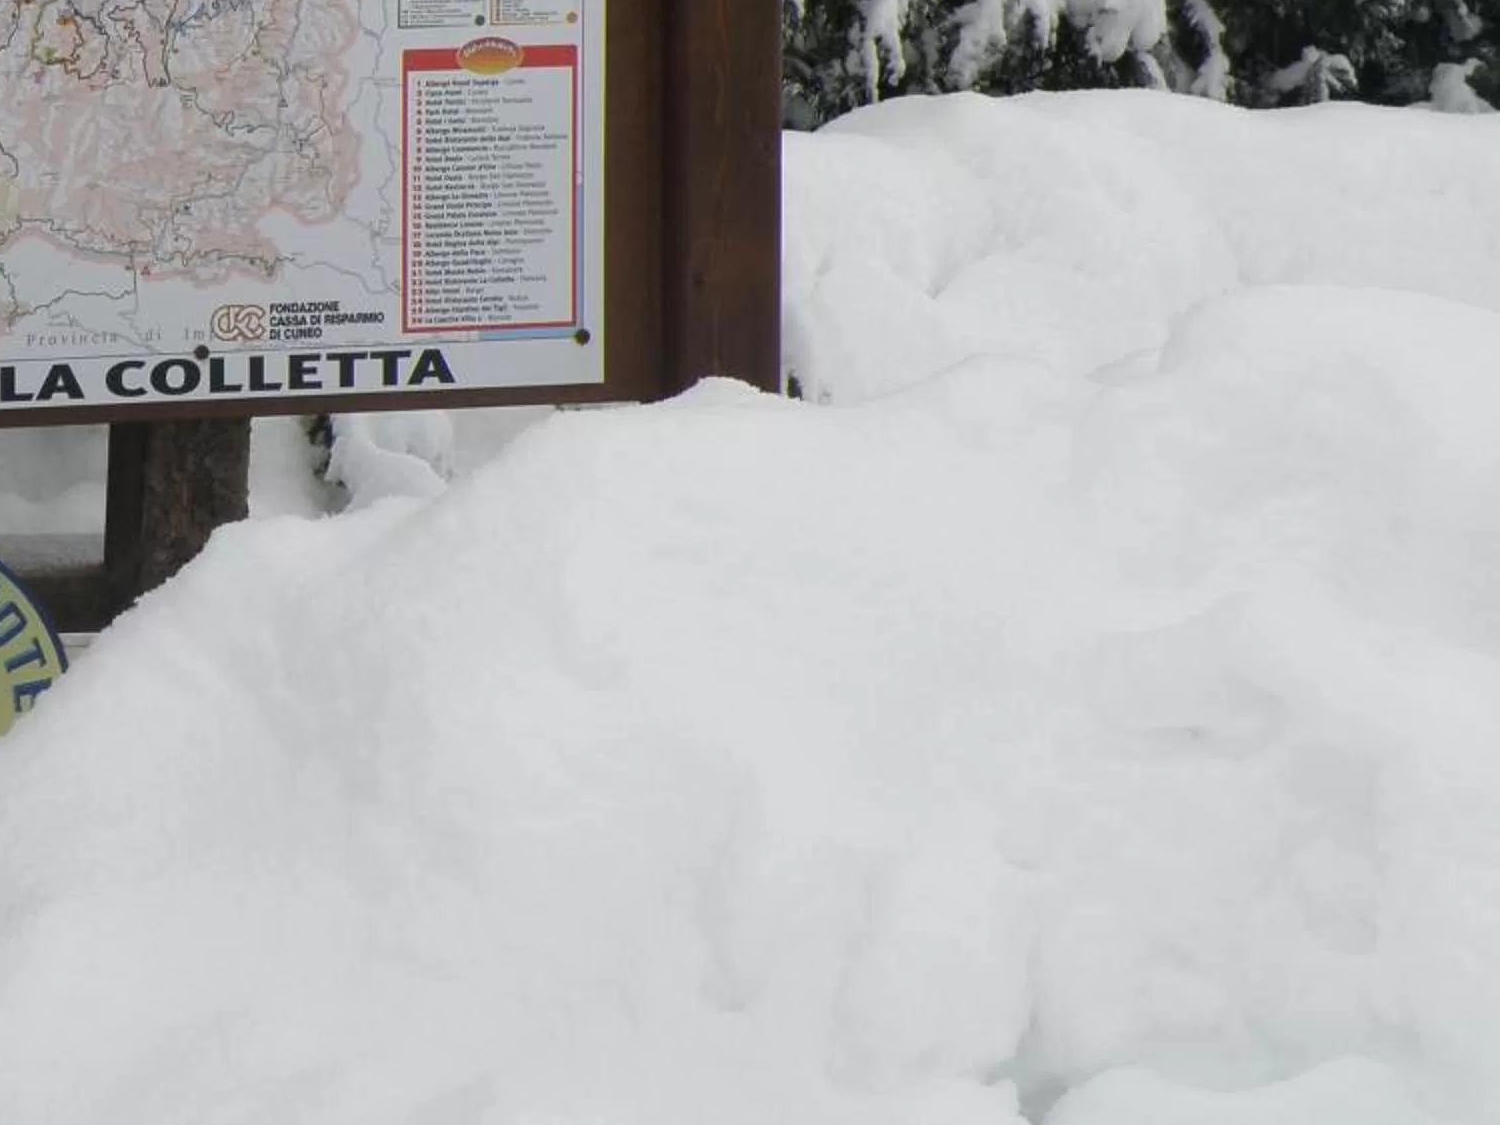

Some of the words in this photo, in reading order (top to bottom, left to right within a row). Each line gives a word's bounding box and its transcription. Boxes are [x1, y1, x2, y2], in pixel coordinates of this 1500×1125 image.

[269, 301, 340, 314] FONDAZIONE
[269, 315, 307, 327] CASSA
[310, 314, 321, 325] DI
[323, 312, 385, 326] RISPARMIO
[26, 331, 118, 347] Provincia
[269, 329, 281, 341] DI
[283, 327, 323, 341] CUNEO
[0, 362, 85, 403] LA
[104, 347, 455, 397] COLLETTA
